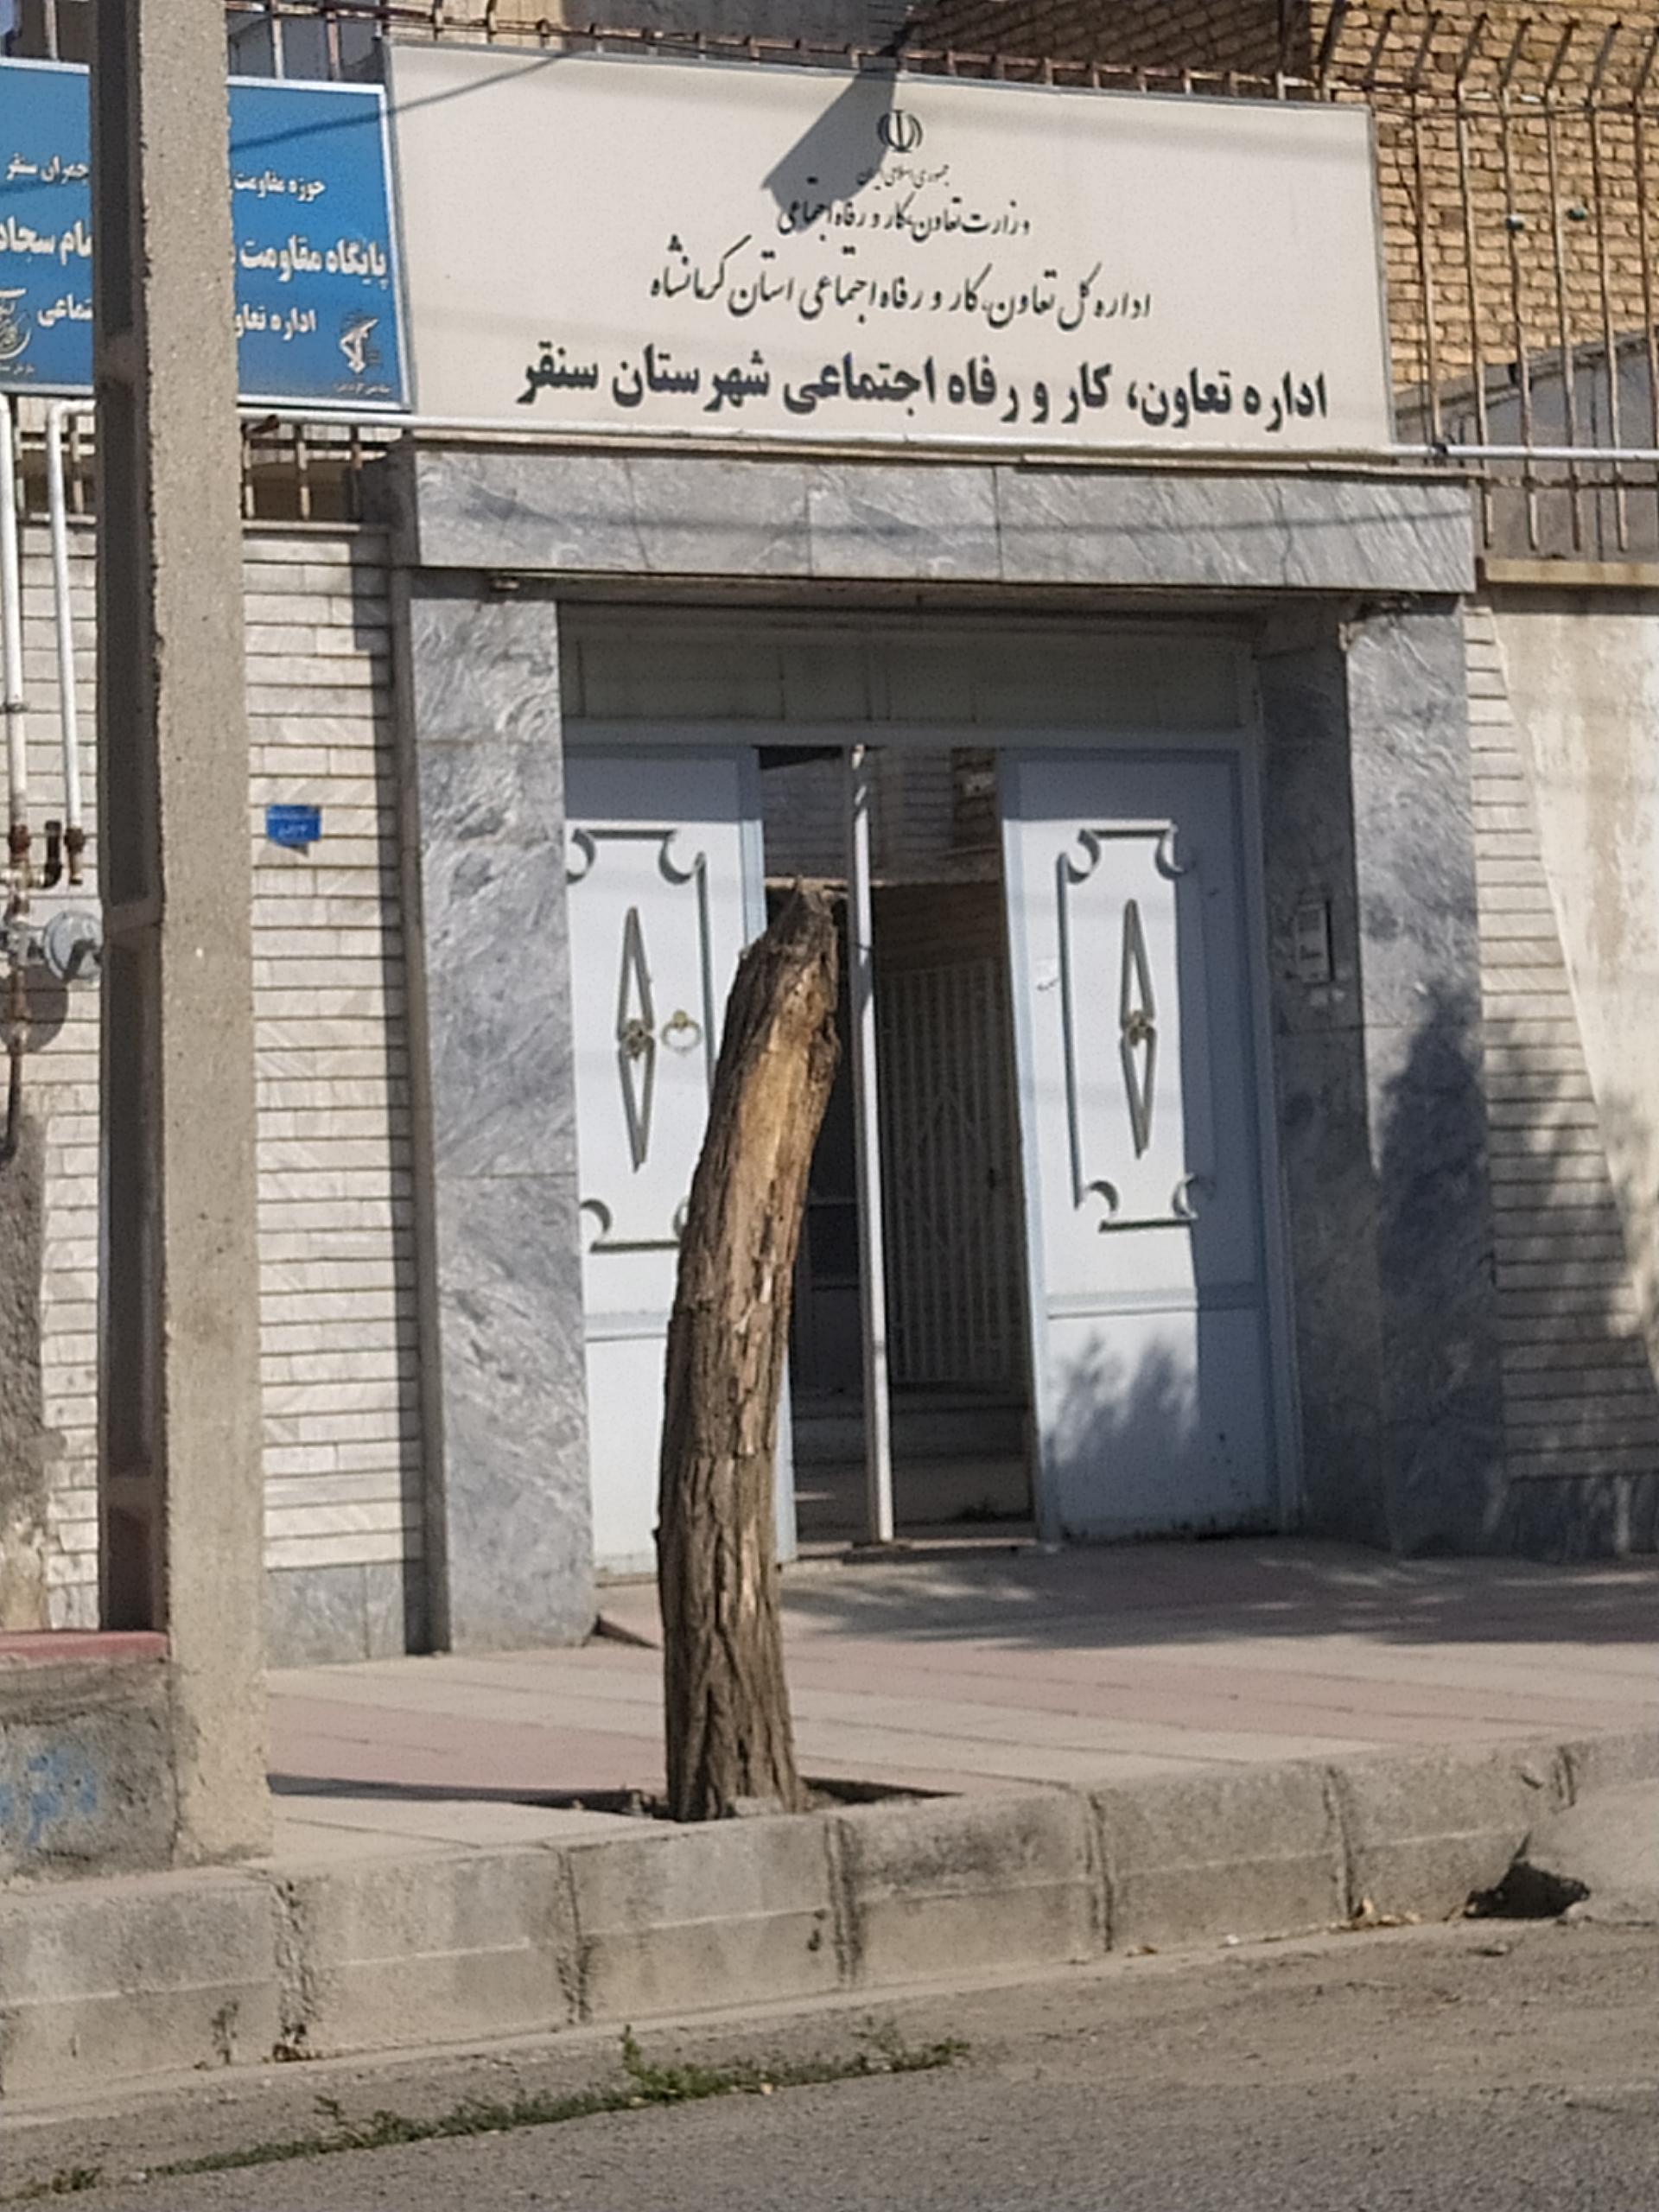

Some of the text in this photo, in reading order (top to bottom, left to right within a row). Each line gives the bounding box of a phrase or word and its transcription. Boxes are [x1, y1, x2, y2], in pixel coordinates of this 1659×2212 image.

[233, 170, 286, 199] مقاومت
[288, 177, 326, 202] حوزه
[778, 176, 833, 242] اجتماعی
[834, 200, 866, 227] رفاه
[871, 213, 880, 228] و
[883, 191, 916, 229] کار
[961, 199, 1031, 235] وزارت
[59, 219, 92, 268] مام
[238, 234, 322, 282] مقاومت
[325, 238, 388, 289] پایگاه
[650, 234, 752, 300] کرمانشاه
[728, 250, 794, 317] استان
[798, 245, 876, 324] اجتماعی
[879, 276, 923, 311] رفاه
[929, 291, 942, 311] و
[949, 262, 992, 312] کار
[1057, 262, 1103, 330] کل
[1093, 292, 1150, 319] اداره
[234, 303, 267, 338] تعاو
[270, 307, 317, 340] اداره
[516, 341, 598, 404] سنقر
[611, 343, 771, 412] شهرستان
[784, 352, 936, 417] اجتماعی
[948, 354, 1020, 423] رفاه
[1060, 361, 1112, 424] کار
[1031, 381, 1050, 423] و
[1243, 371, 1327, 431] اداره
